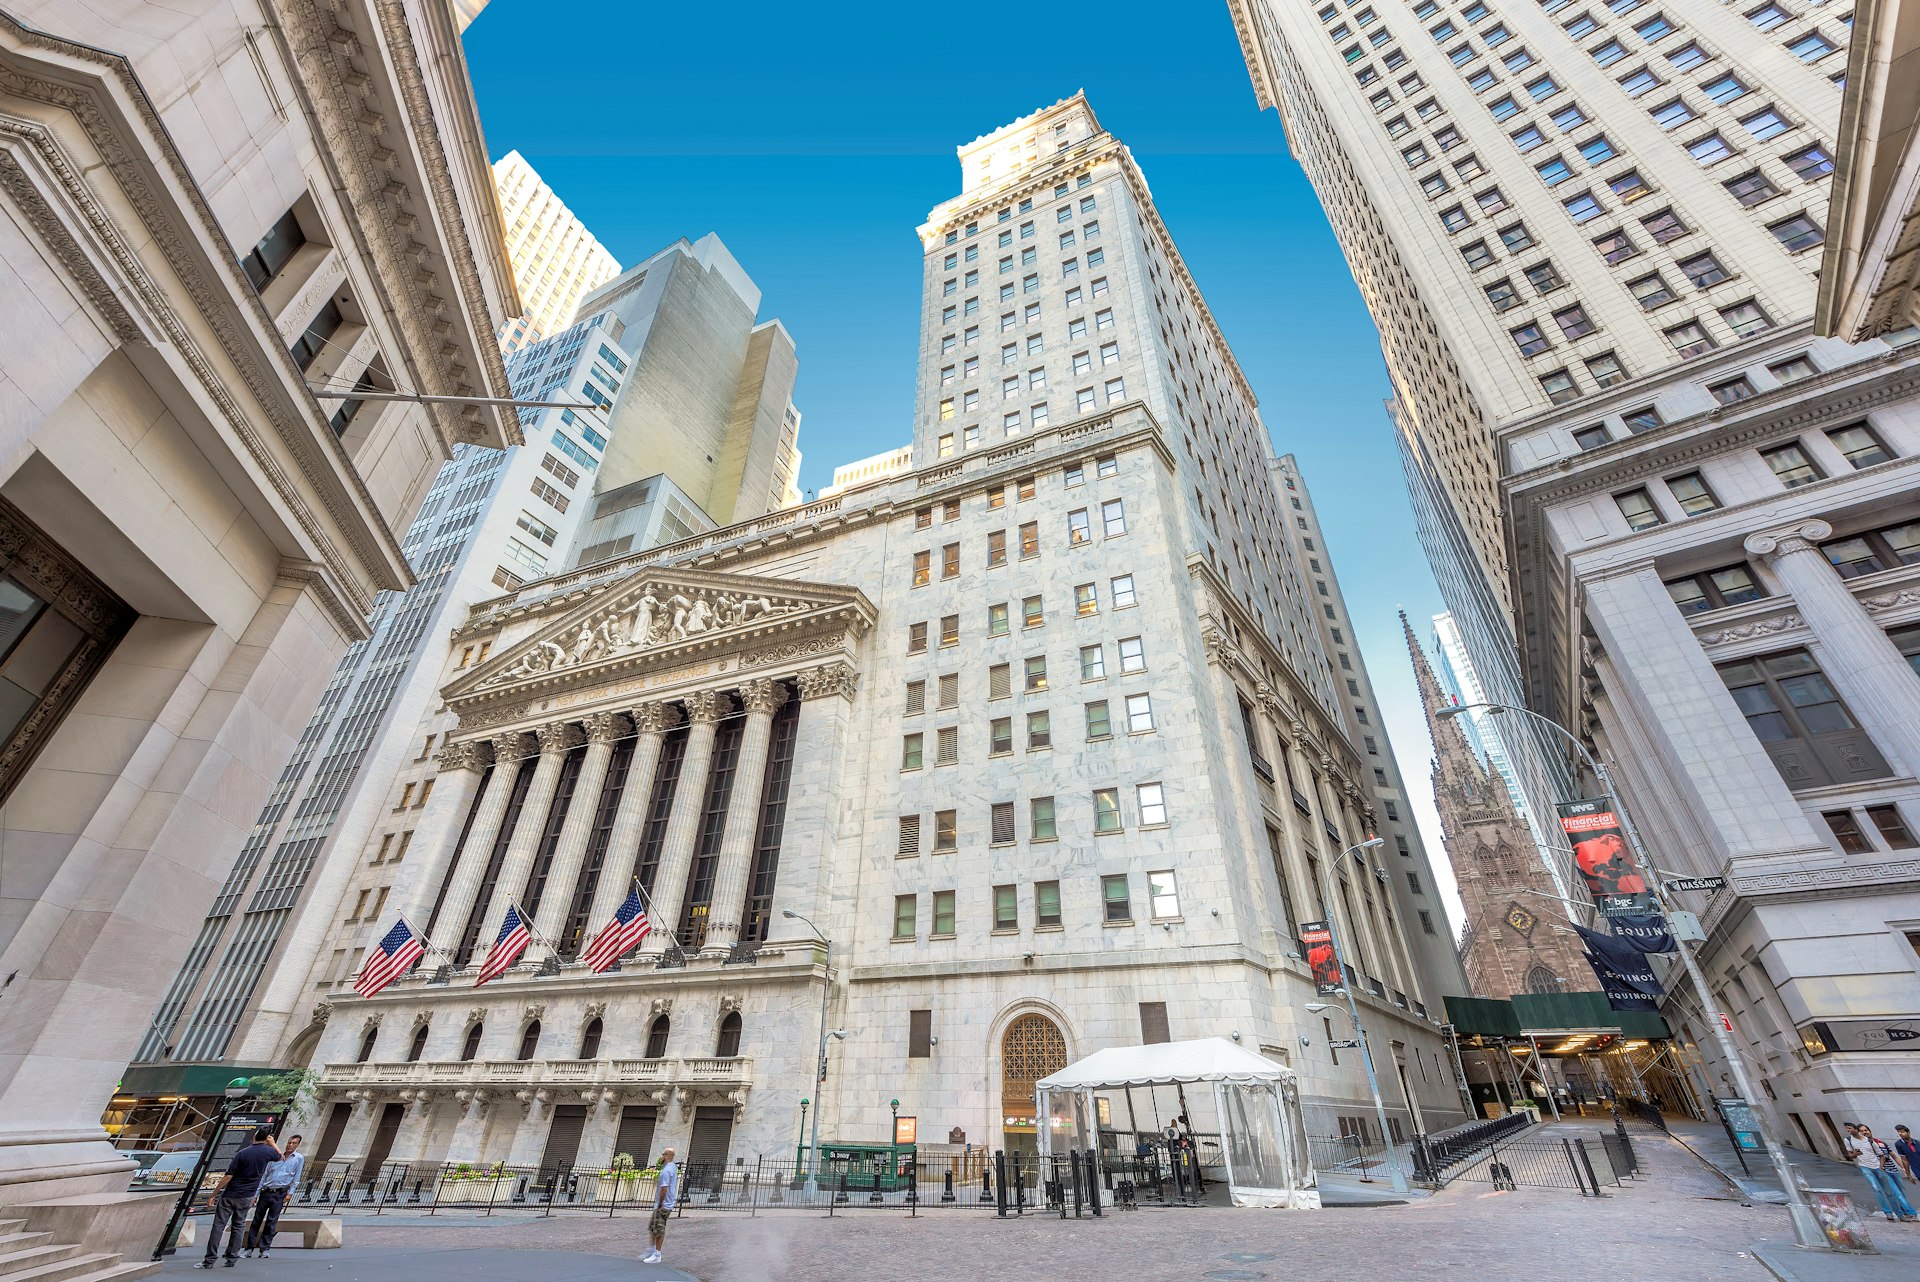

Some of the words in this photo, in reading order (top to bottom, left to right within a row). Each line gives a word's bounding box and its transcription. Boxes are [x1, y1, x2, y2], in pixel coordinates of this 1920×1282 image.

[556, 694, 578, 708] NEW
[583, 687, 609, 701] YORK
[614, 680, 646, 695] STOCK
[652, 666, 709, 685] EXCHANGE
[1571, 804, 1595, 812] NYC
[1563, 814, 1613, 828] financial
[1680, 879, 1717, 890] NASSAU
[1613, 897, 1633, 907] bgc
[1303, 931, 1329, 941] financial
[1608, 992, 1654, 1001] EQUINOX
